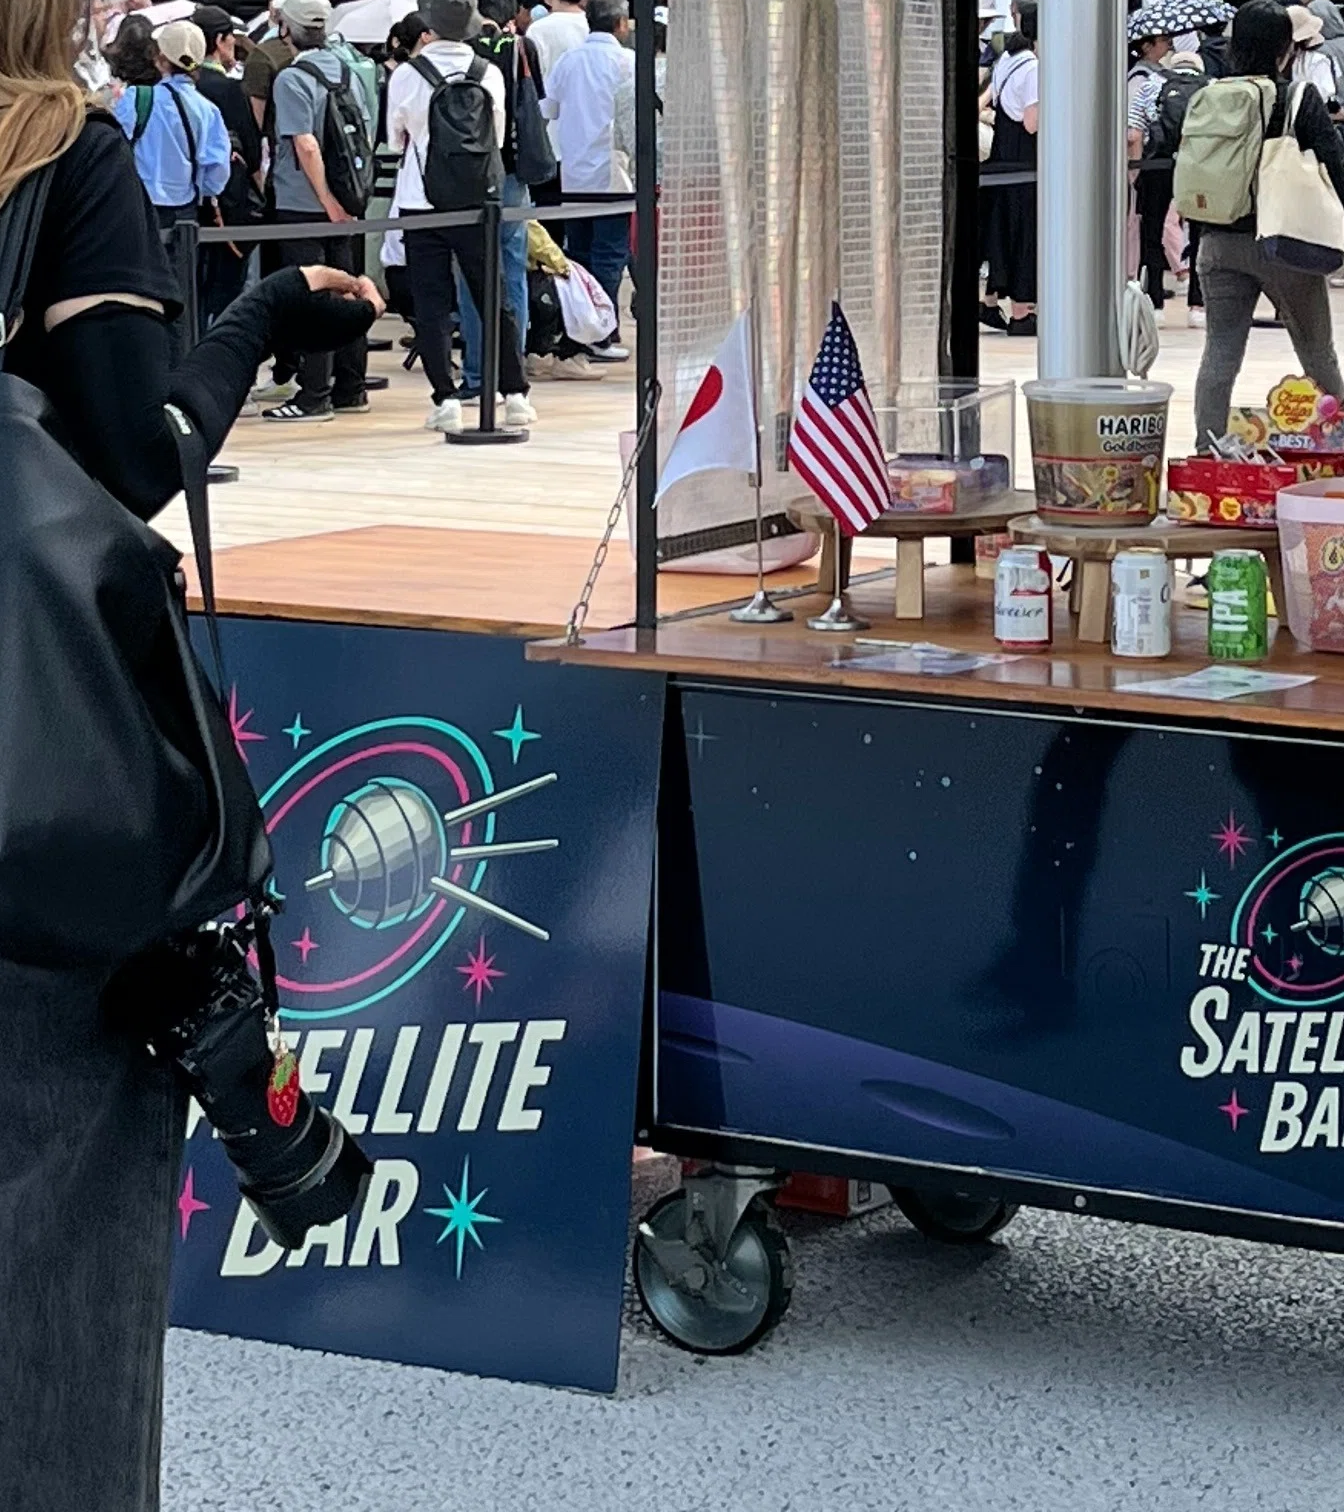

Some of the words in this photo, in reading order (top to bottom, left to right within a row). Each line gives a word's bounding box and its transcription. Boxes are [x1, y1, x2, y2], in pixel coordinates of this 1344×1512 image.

[1098, 413, 1166, 437] HARIBO
[1212, 589, 1249, 632] IPA
[1199, 944, 1251, 980] THE
